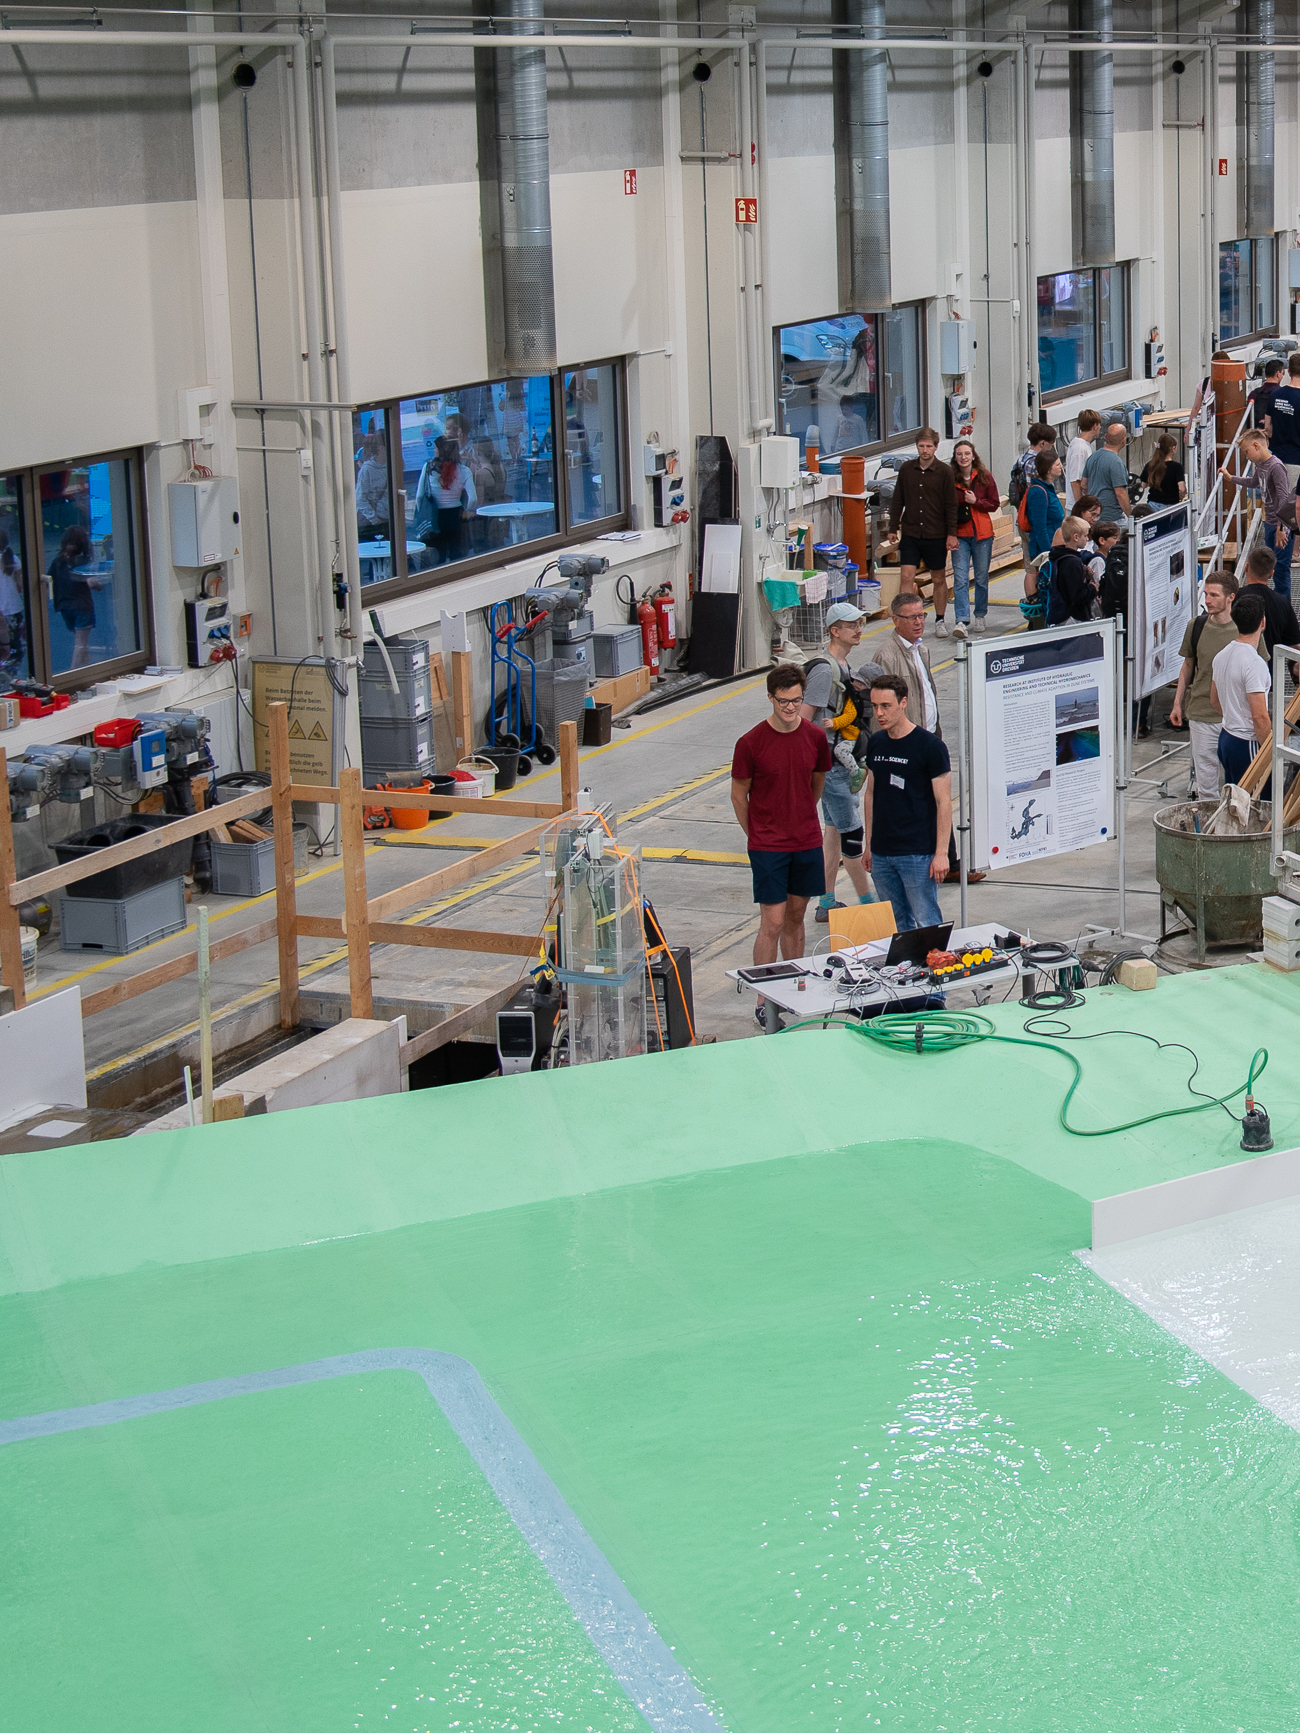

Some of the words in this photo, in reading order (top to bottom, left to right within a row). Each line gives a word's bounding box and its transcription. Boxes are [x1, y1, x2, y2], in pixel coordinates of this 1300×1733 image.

[1052, 671, 1073, 679] HYDRAULIC
[1003, 686, 1028, 694] ENGINEERING
[1038, 680, 1058, 688] TECHNICAL
[1059, 673, 1091, 683] HYDROMECHANICS
[1003, 692, 1024, 700] RESISTANCE
[290, 751, 315, 759] benutzen
